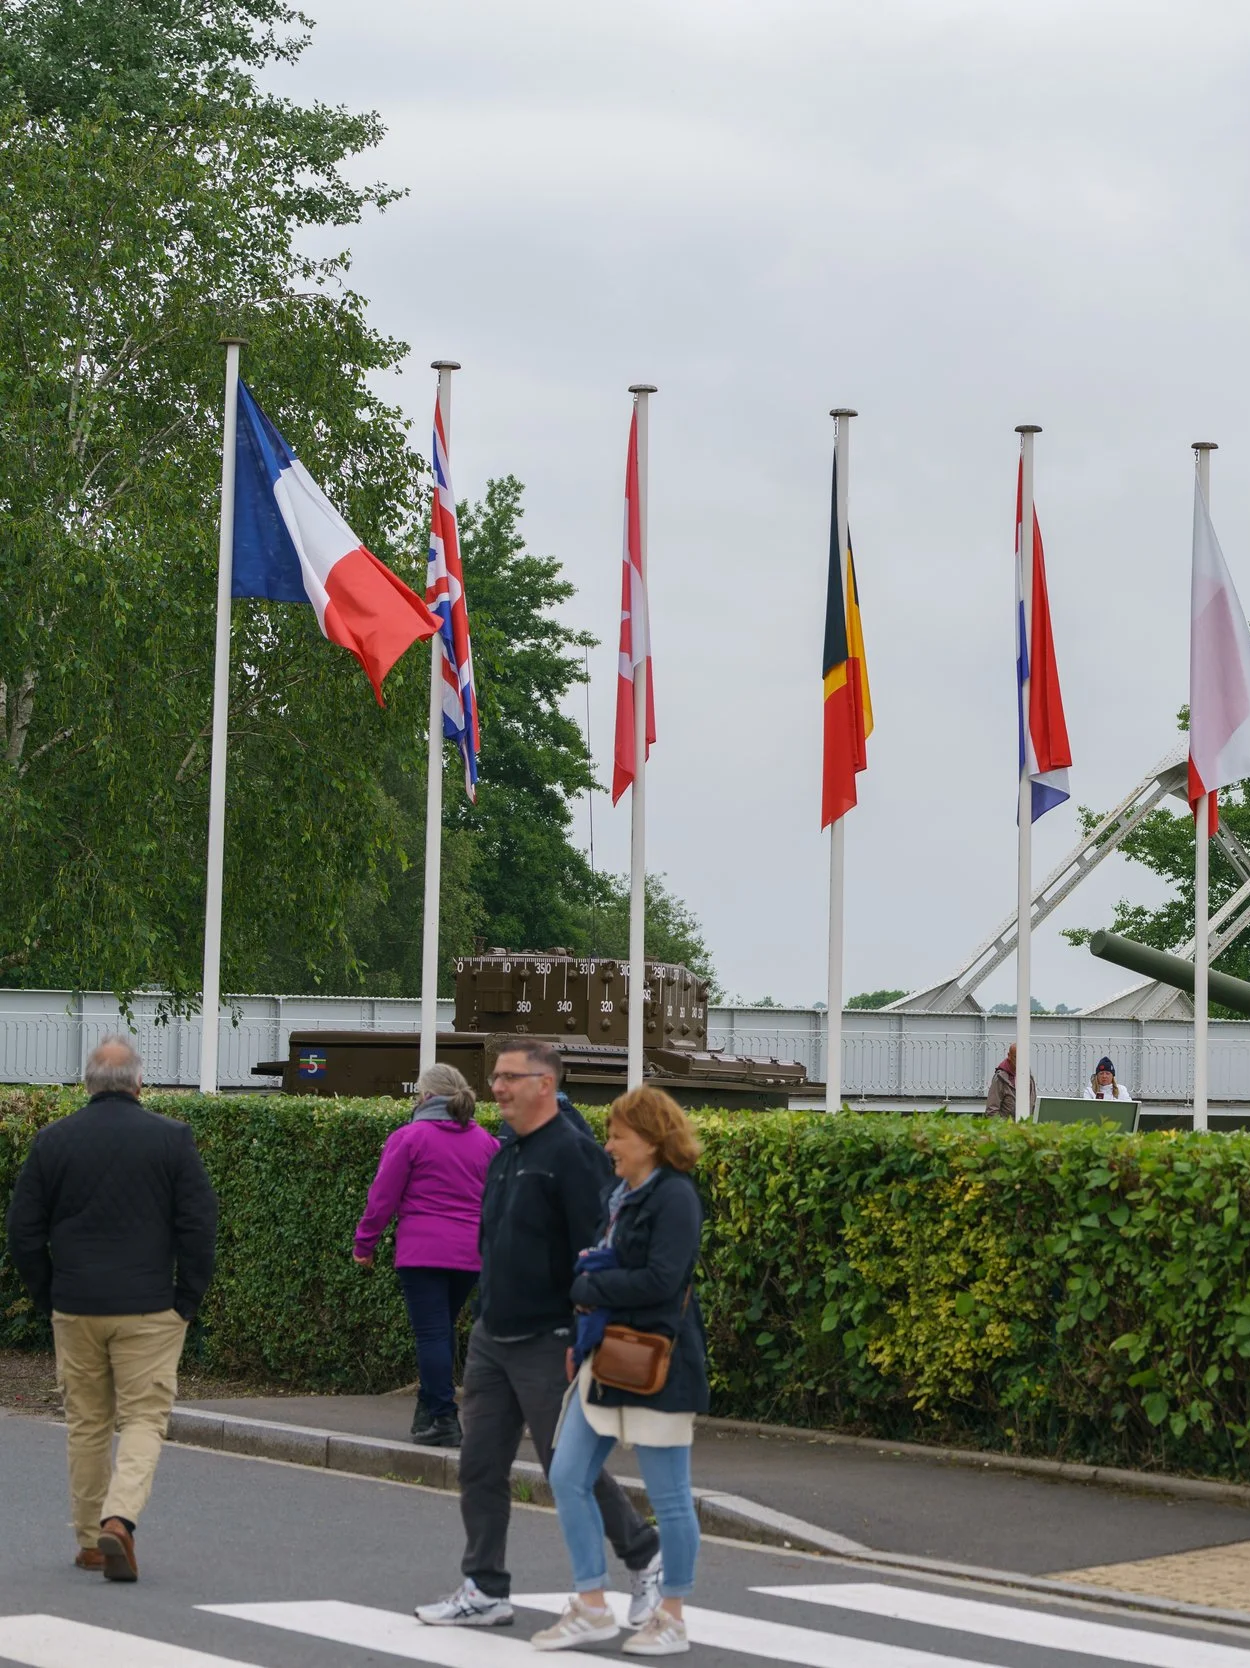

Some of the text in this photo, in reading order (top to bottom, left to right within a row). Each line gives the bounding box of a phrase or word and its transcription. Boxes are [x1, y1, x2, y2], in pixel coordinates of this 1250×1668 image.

[535, 963, 552, 974] 350
[579, 963, 596, 975] 330
[516, 1001, 532, 1013] 360
[557, 1001, 572, 1012] 340
[600, 1001, 613, 1012] 320
[307, 1054, 318, 1074] 5
